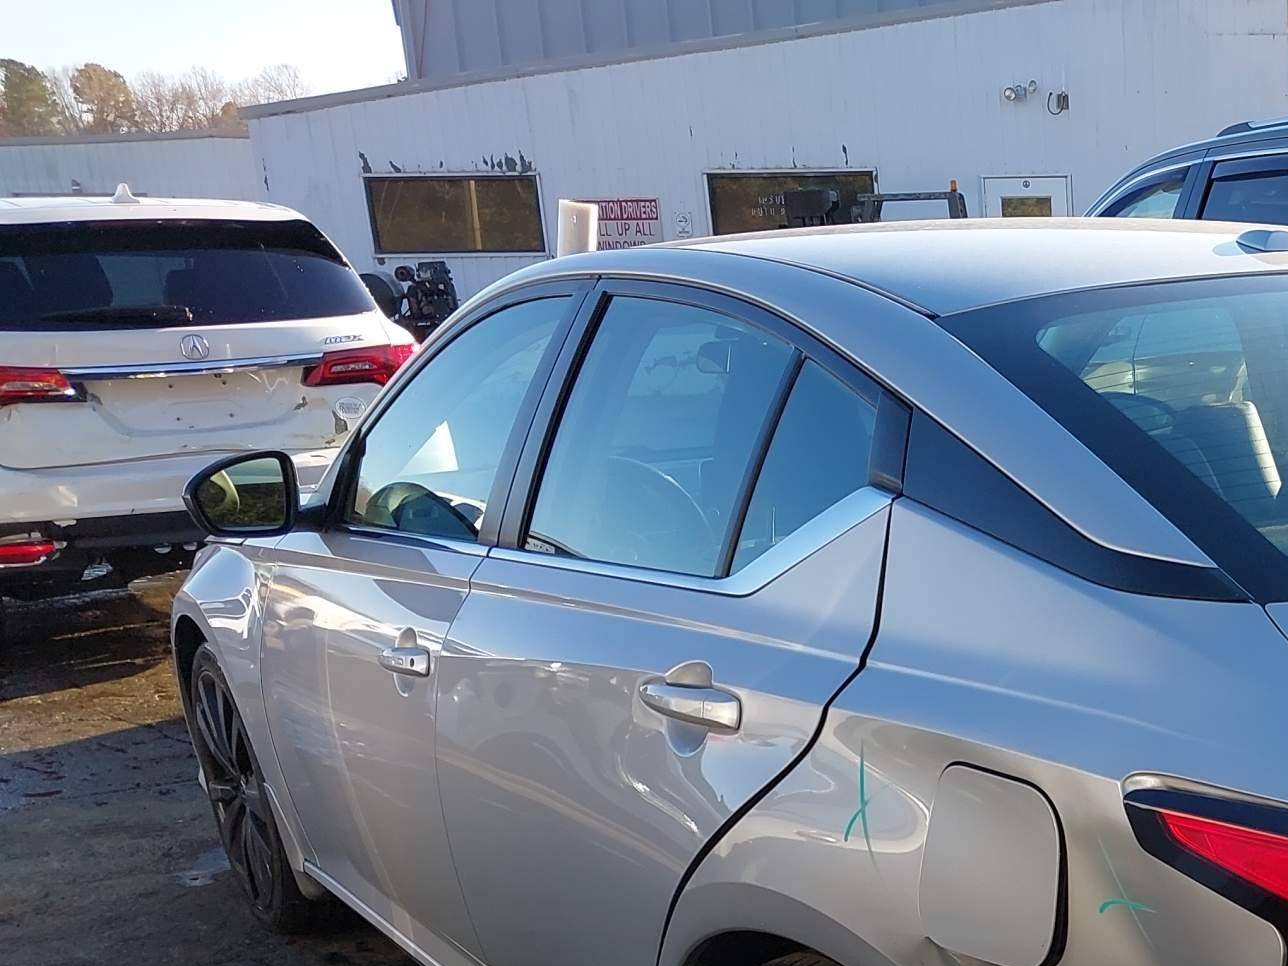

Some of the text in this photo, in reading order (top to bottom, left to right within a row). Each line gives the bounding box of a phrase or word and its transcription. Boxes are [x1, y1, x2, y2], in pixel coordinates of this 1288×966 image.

[621, 201, 657, 219] DRIVERS
[598, 222, 656, 237] LL UP ALL
